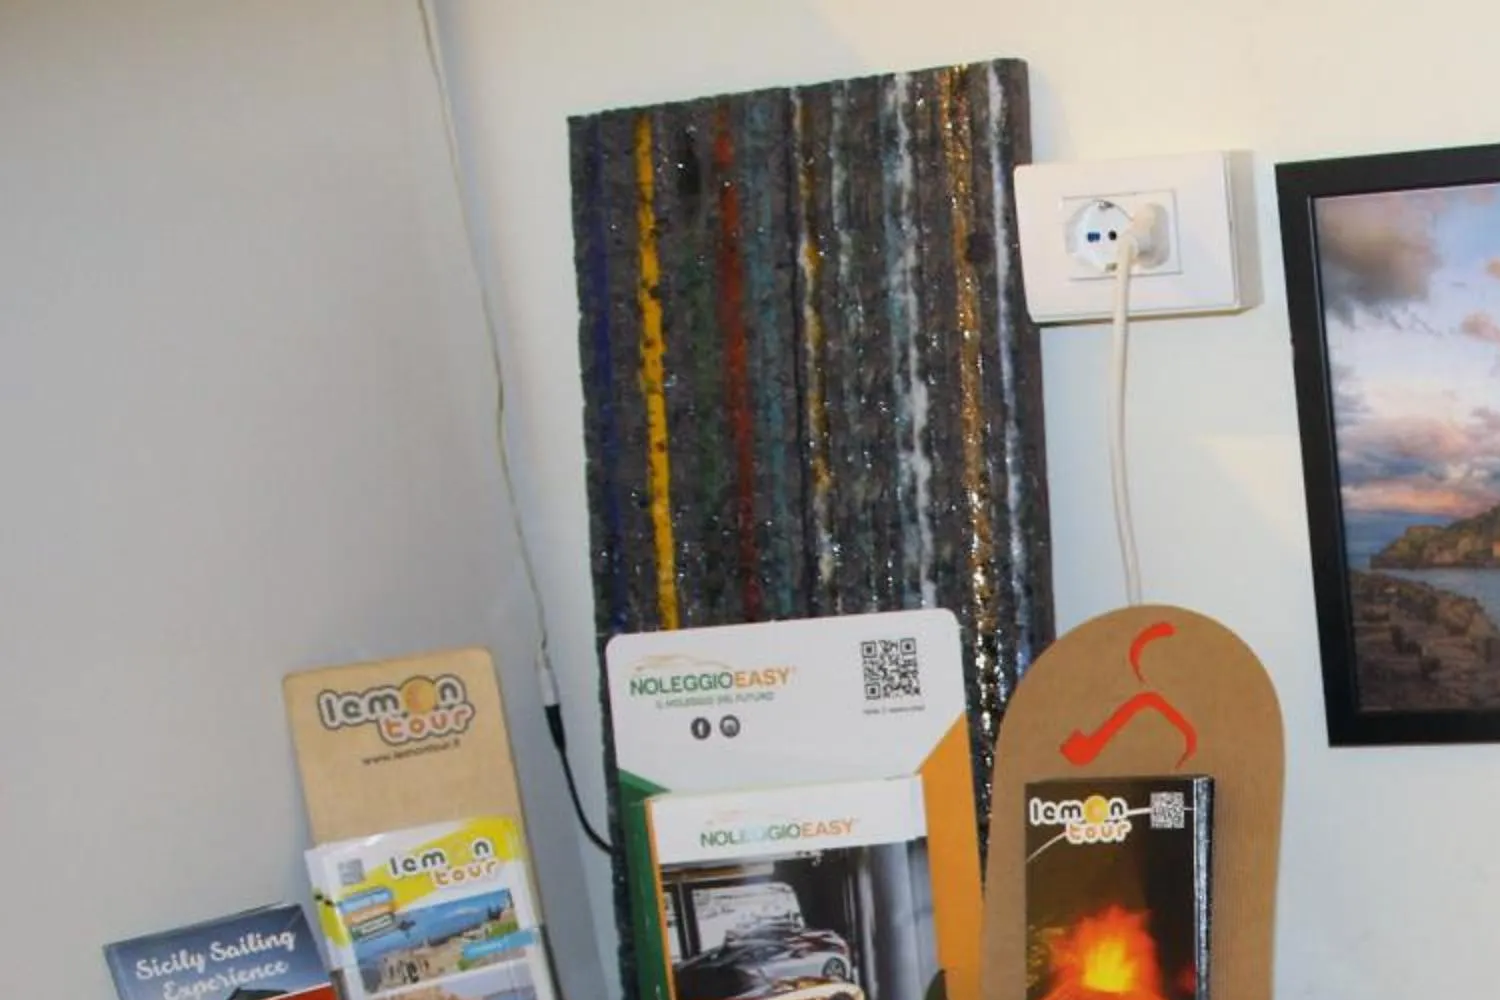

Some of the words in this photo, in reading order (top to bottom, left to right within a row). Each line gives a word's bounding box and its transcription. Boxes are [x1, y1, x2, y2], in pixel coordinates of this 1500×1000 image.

[629, 667, 790, 696] NOLEGGIOEASY
[380, 703, 474, 745] tour
[1065, 820, 1132, 843] tour
[433, 860, 497, 886] tour
[136, 949, 206, 980] Sicily
[210, 930, 296, 961] Sailing
